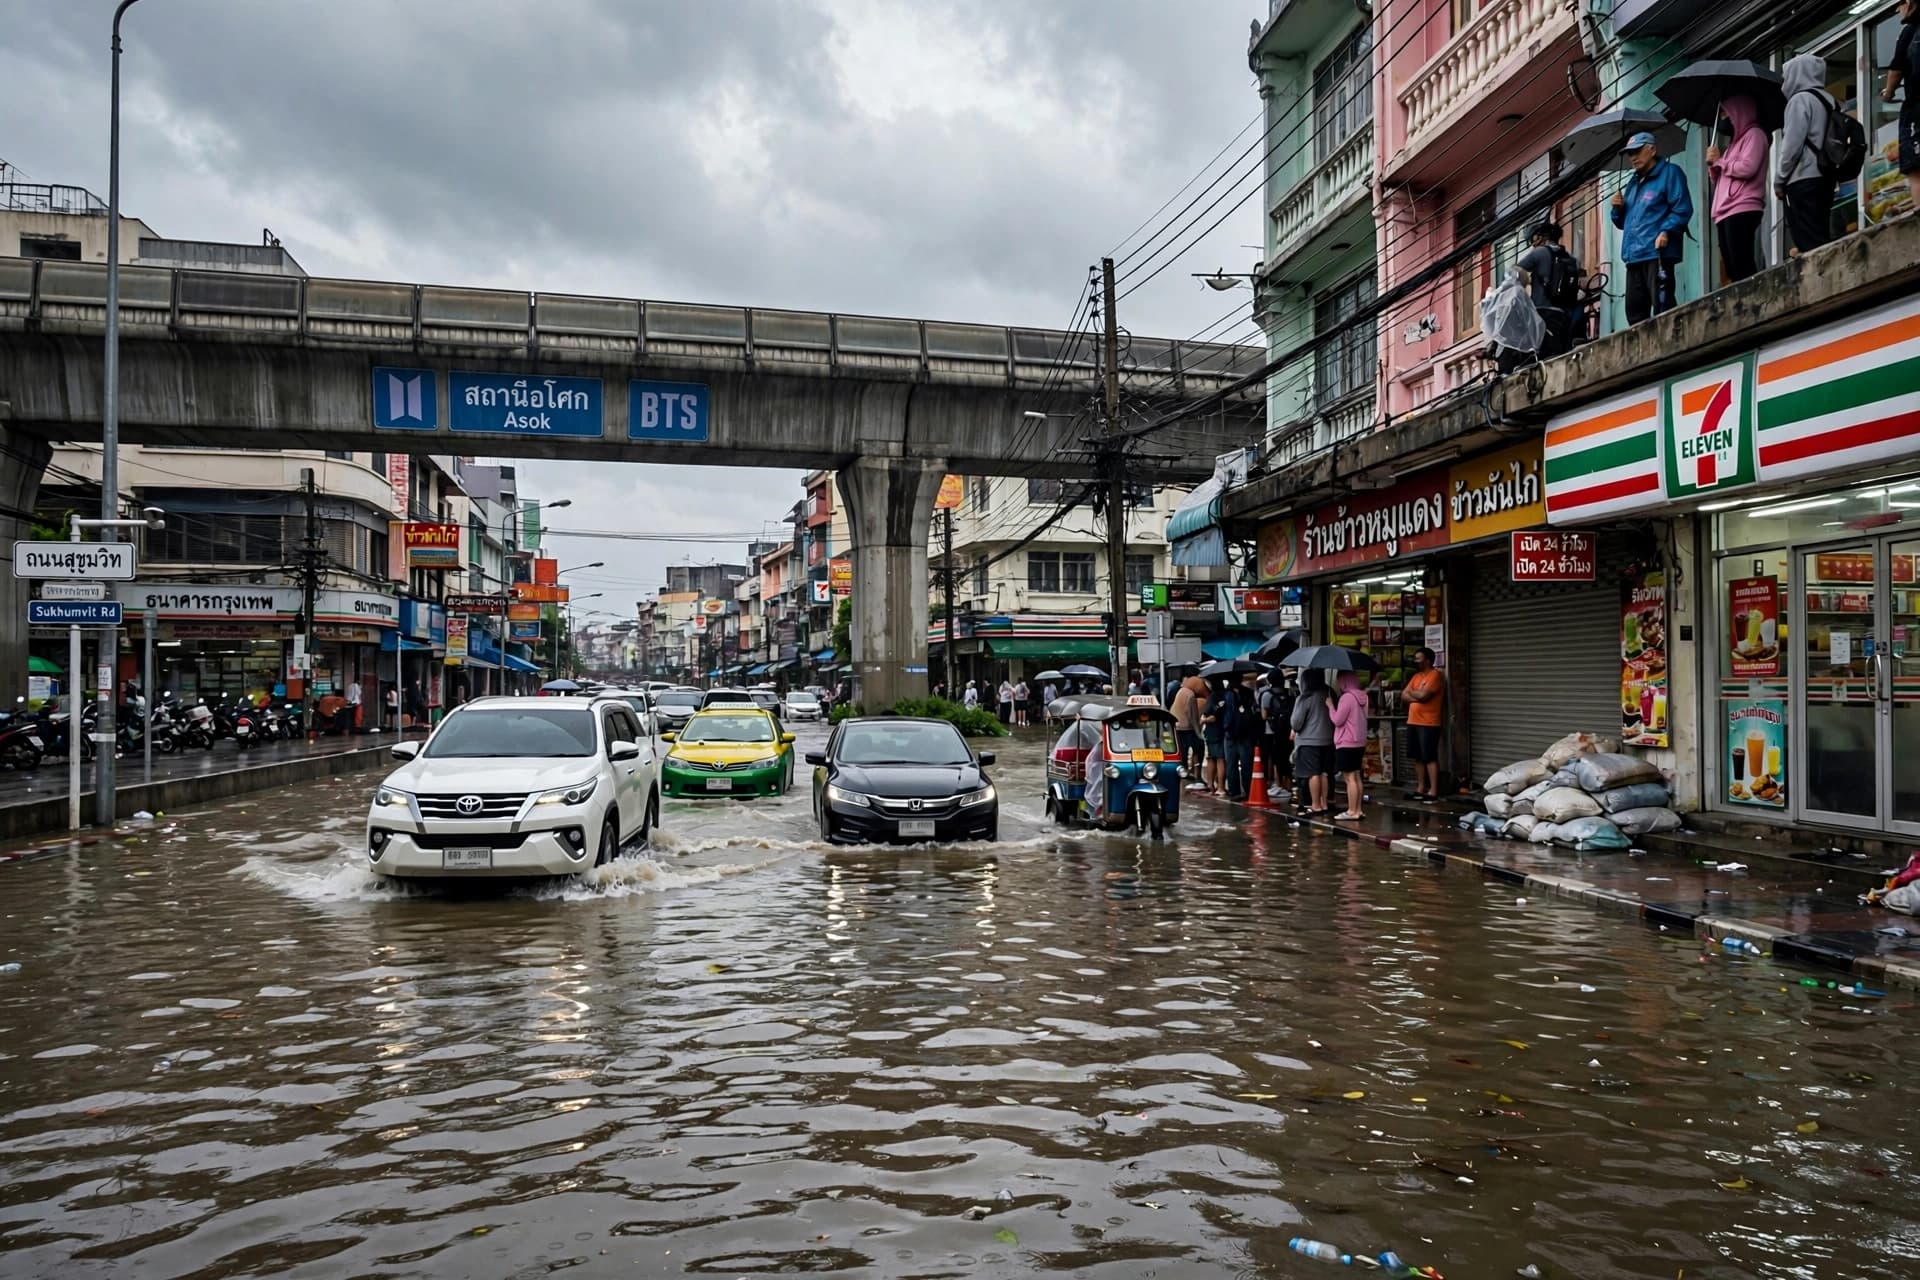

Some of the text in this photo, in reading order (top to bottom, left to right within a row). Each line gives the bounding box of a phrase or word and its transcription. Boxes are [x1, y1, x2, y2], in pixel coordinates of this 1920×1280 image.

[464, 379, 589, 411] สถานีอโศก
[641, 391, 698, 430] BTS
[504, 411, 551, 430] Asok
[1681, 379, 1732, 487] 7
[1681, 428, 1733, 459] ELEVEN
[1450, 459, 1538, 521] ข้าวมันไก่
[1302, 492, 1443, 557] ร้านข้าวหมูแดง
[1543, 537, 1558, 551] 24
[1540, 559, 1555, 574] 24
[36, 606, 116, 617] Sukhumvit Rd
